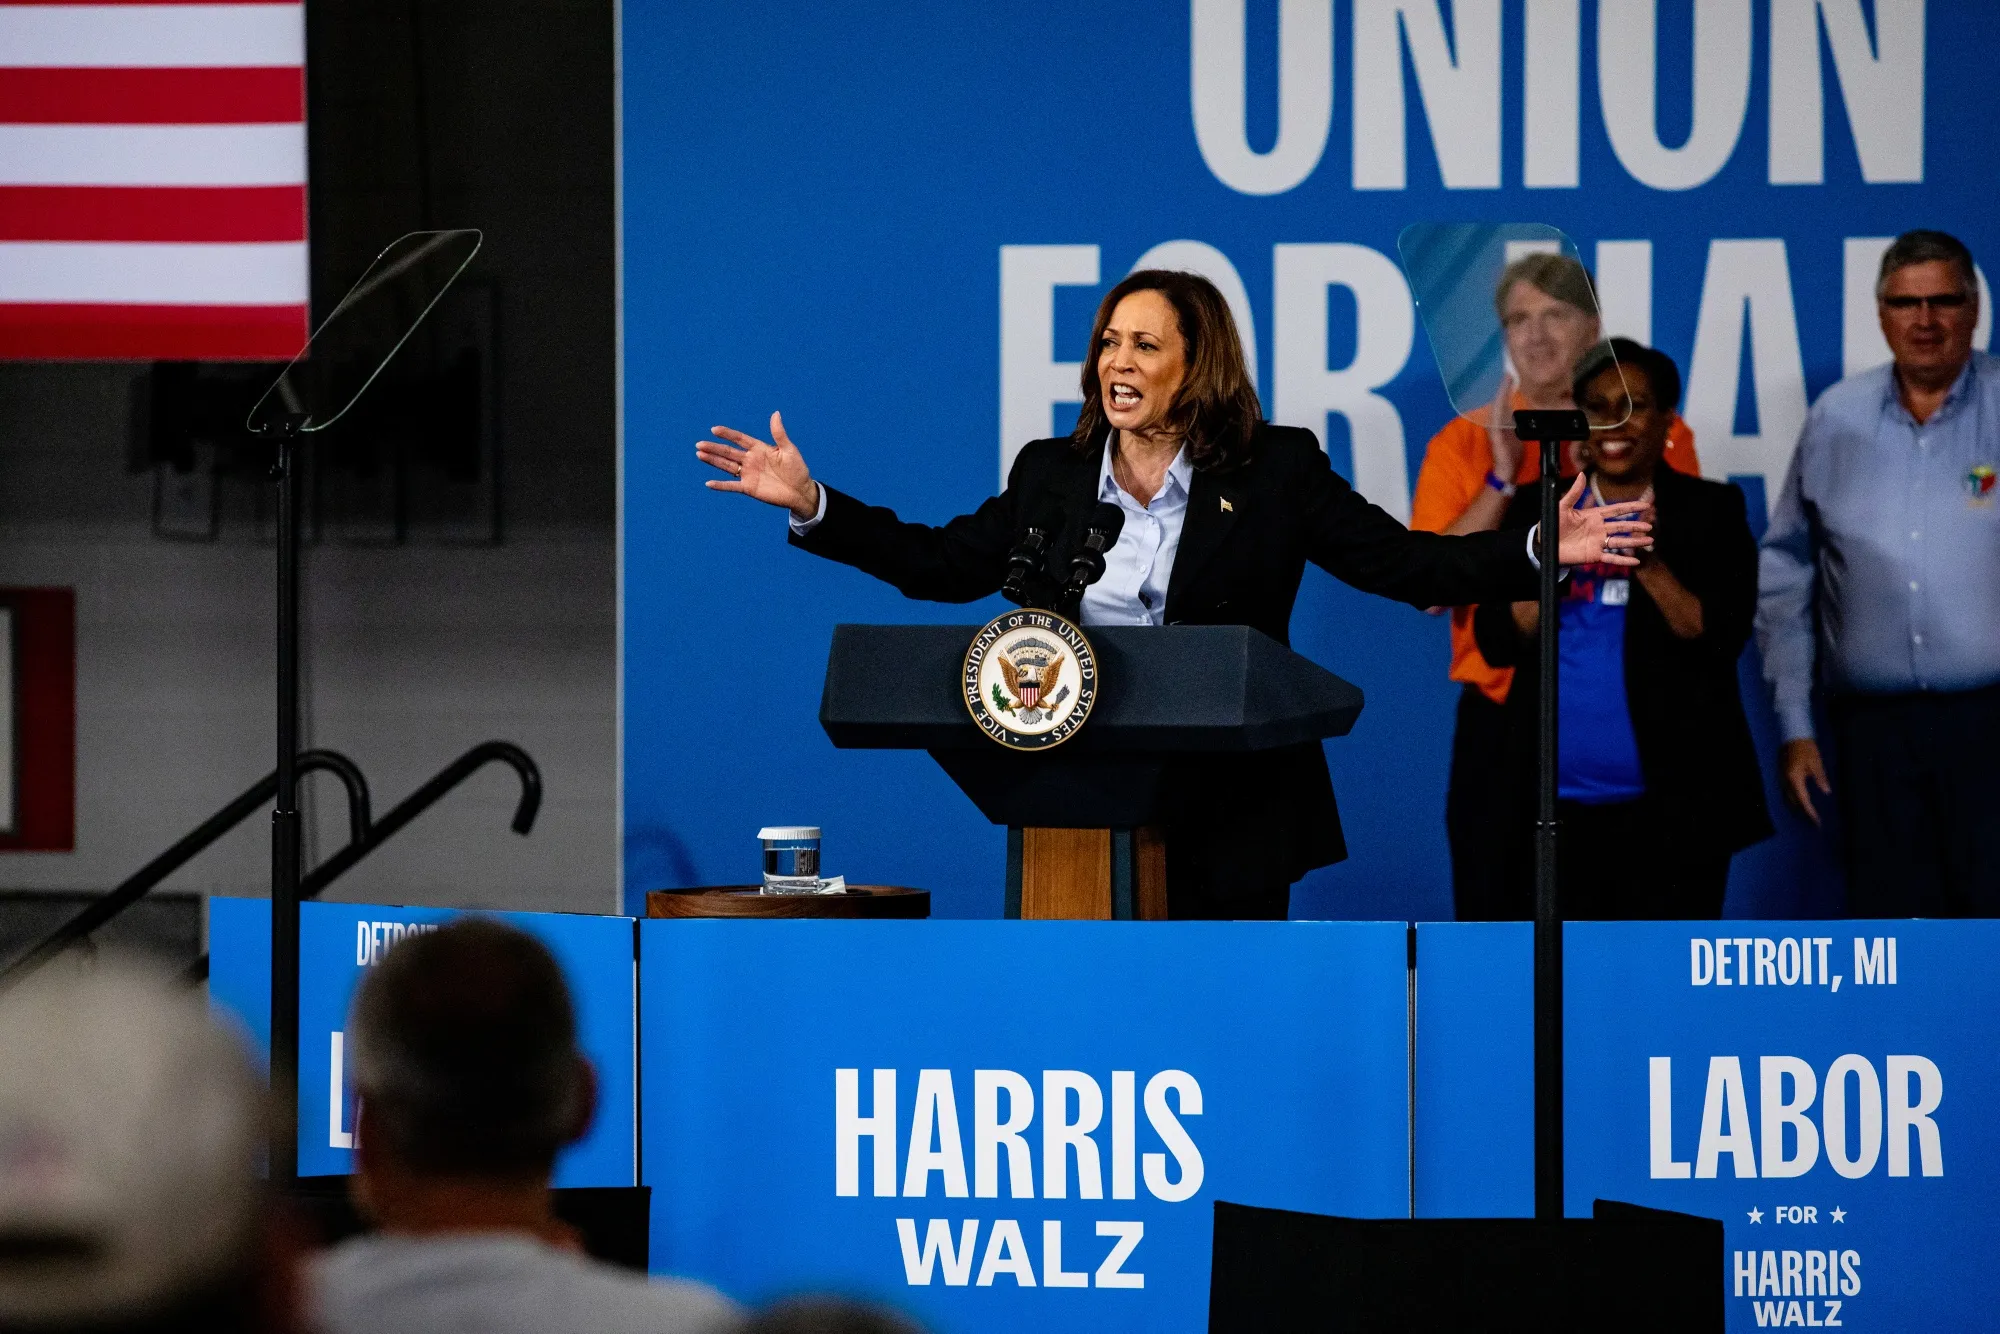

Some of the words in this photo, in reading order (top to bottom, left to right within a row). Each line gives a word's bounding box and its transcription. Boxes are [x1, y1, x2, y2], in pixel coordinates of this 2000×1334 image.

[1008, 615, 1023, 627] OF
[1029, 614, 1053, 628] THE
[966, 621, 1002, 704] PRESIDENT
[1058, 624, 1094, 680] UNITED
[976, 708, 1007, 741] VICE
[1052, 689, 1093, 741] STATES
[1690, 937, 1843, 993] DETROIT,
[1854, 937, 1897, 985] MI
[836, 1068, 1204, 1202] HARRIS
[1649, 1053, 1944, 1180] LABOR
[1776, 1206, 1818, 1224] FOR
[896, 1218, 1144, 1288] WALZ
[1734, 1250, 1861, 1297] HARRIS
[1752, 1301, 1842, 1328] WALZ
